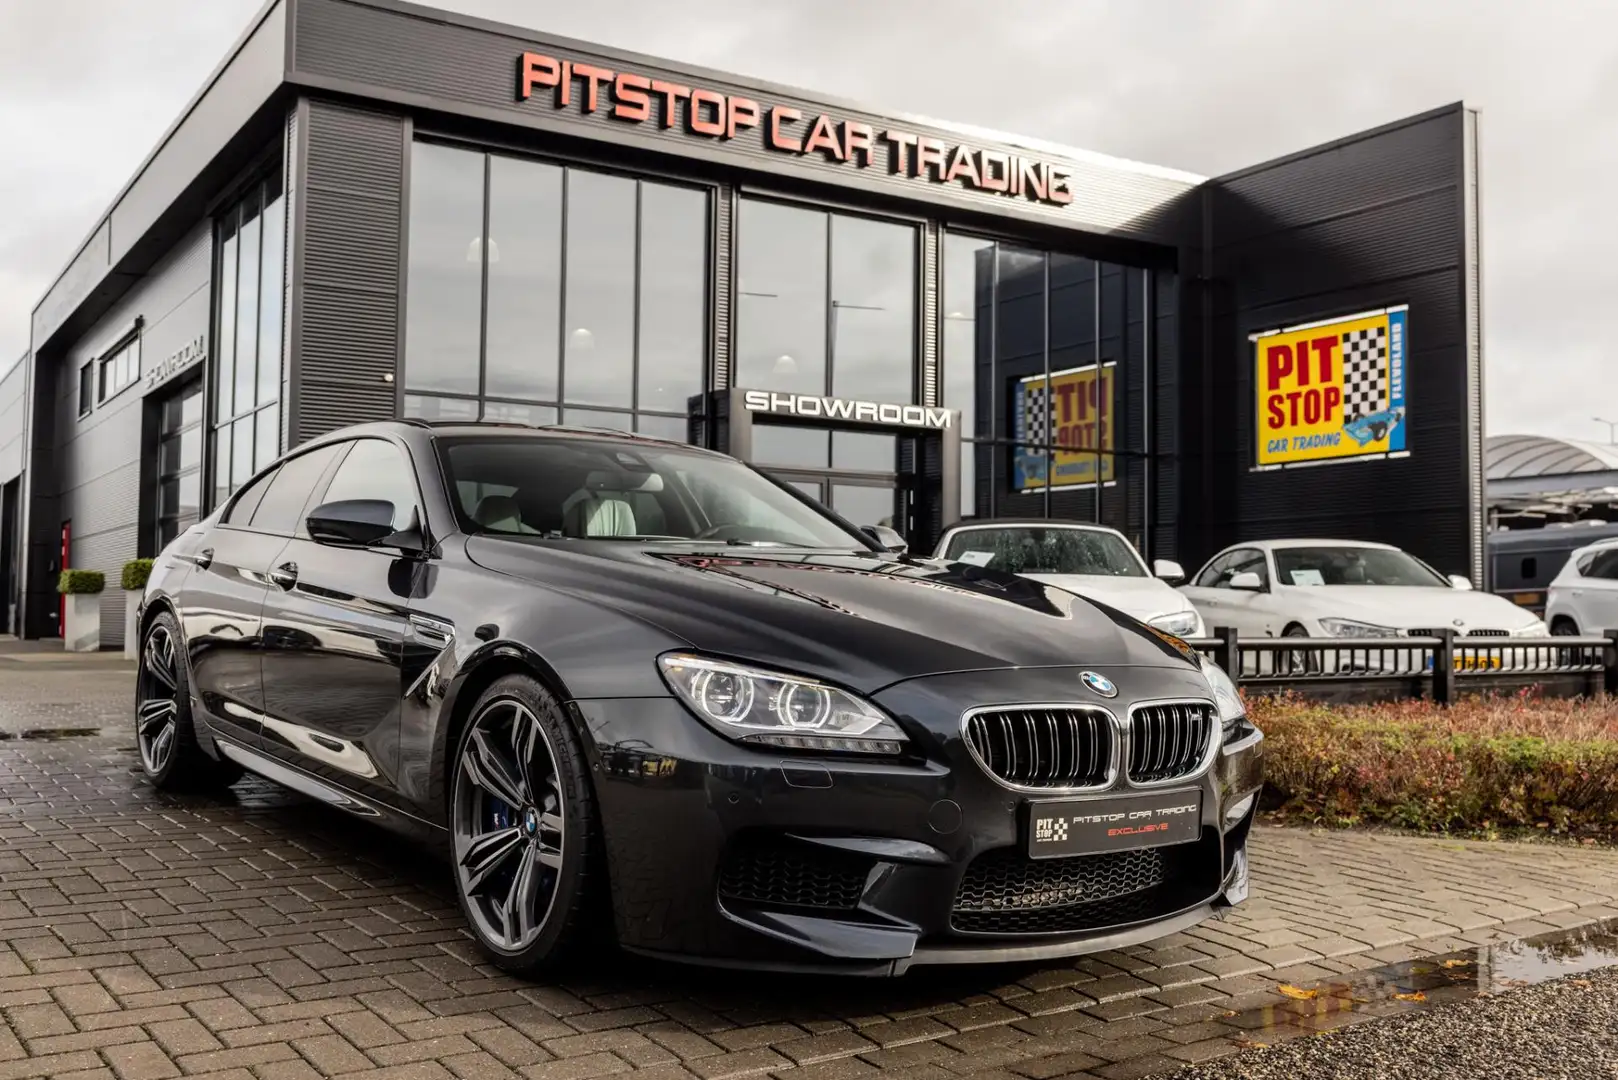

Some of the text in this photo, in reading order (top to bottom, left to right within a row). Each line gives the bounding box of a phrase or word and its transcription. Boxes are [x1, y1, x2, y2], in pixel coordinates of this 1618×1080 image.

[520, 51, 1073, 204] PITSTOP CAR TRADING
[1267, 335, 1338, 390] PIT
[745, 390, 951, 428] SHOWROOM
[1268, 386, 1340, 429] STOP
[1268, 432, 1341, 453] CAR TRADING
[1036, 818, 1054, 829] PIT
[1073, 804, 1197, 824] PITSTOP CAR TRADING
[1036, 829, 1053, 838] STOP
[1108, 823, 1168, 836] EXCLUSIVE
